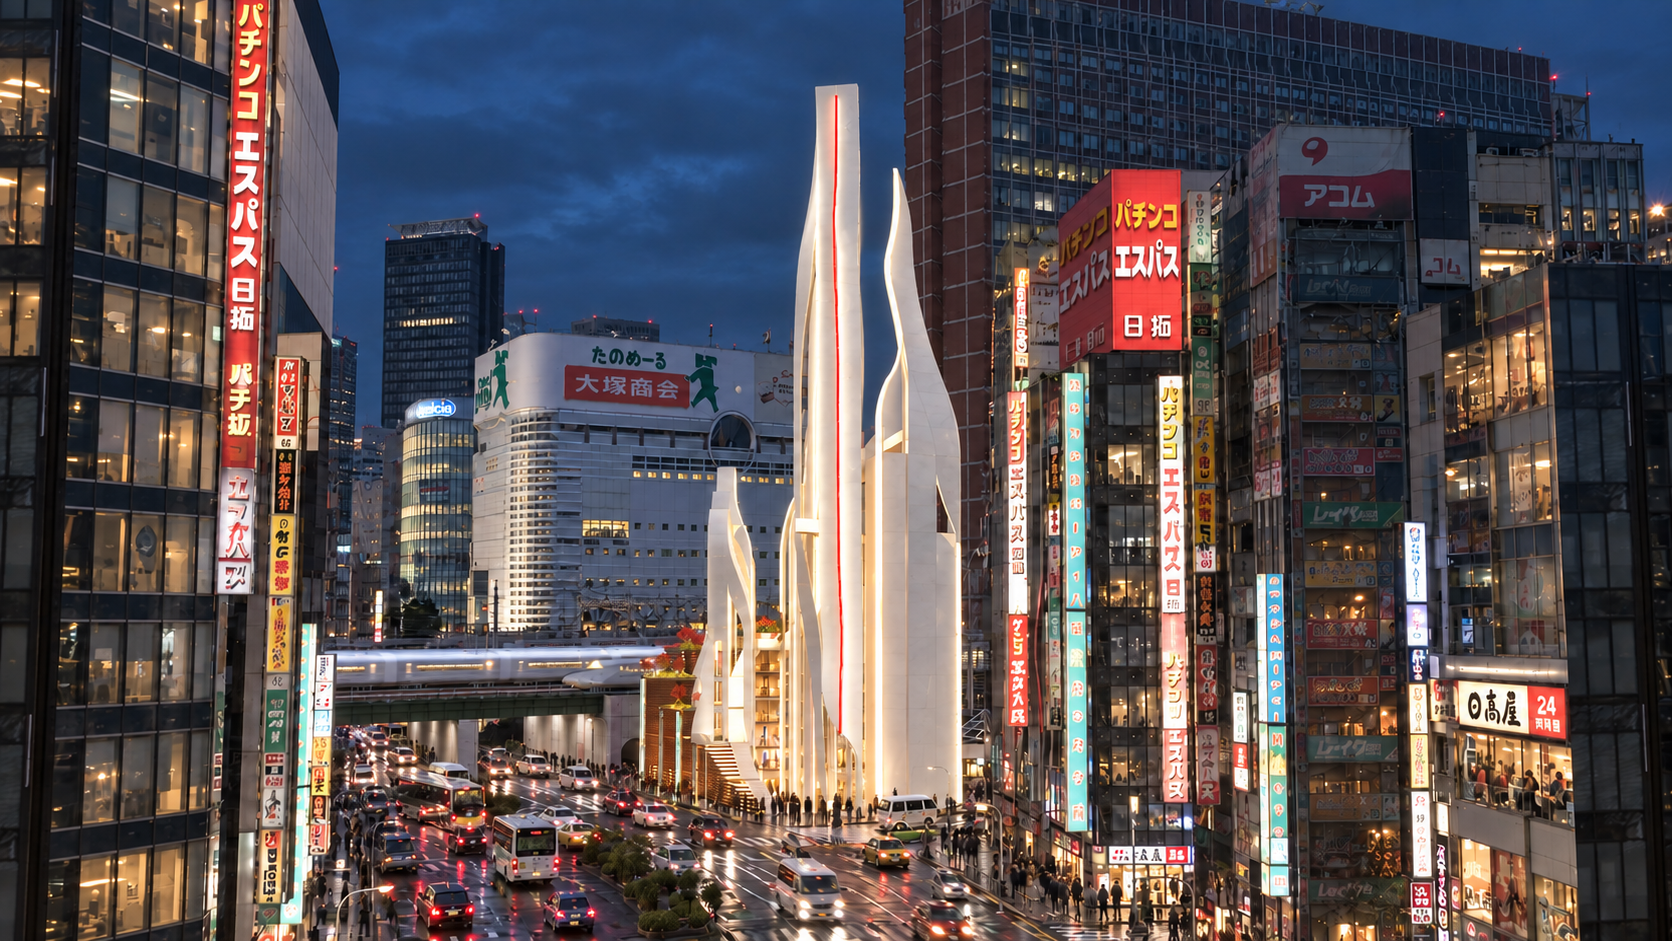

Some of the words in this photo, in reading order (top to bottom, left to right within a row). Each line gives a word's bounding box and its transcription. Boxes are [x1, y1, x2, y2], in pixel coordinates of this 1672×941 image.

[237, 3, 264, 121] パチンコ
[230, 132, 261, 269] エスパス
[1304, 184, 1375, 208] アコム
[1115, 198, 1177, 229] パチンコ
[1115, 239, 1180, 278] エスパス
[592, 346, 667, 370] たのめーる
[575, 374, 679, 400] 大塚商会
[1468, 689, 1521, 727] 日高屋
[1537, 695, 1557, 716] 24
